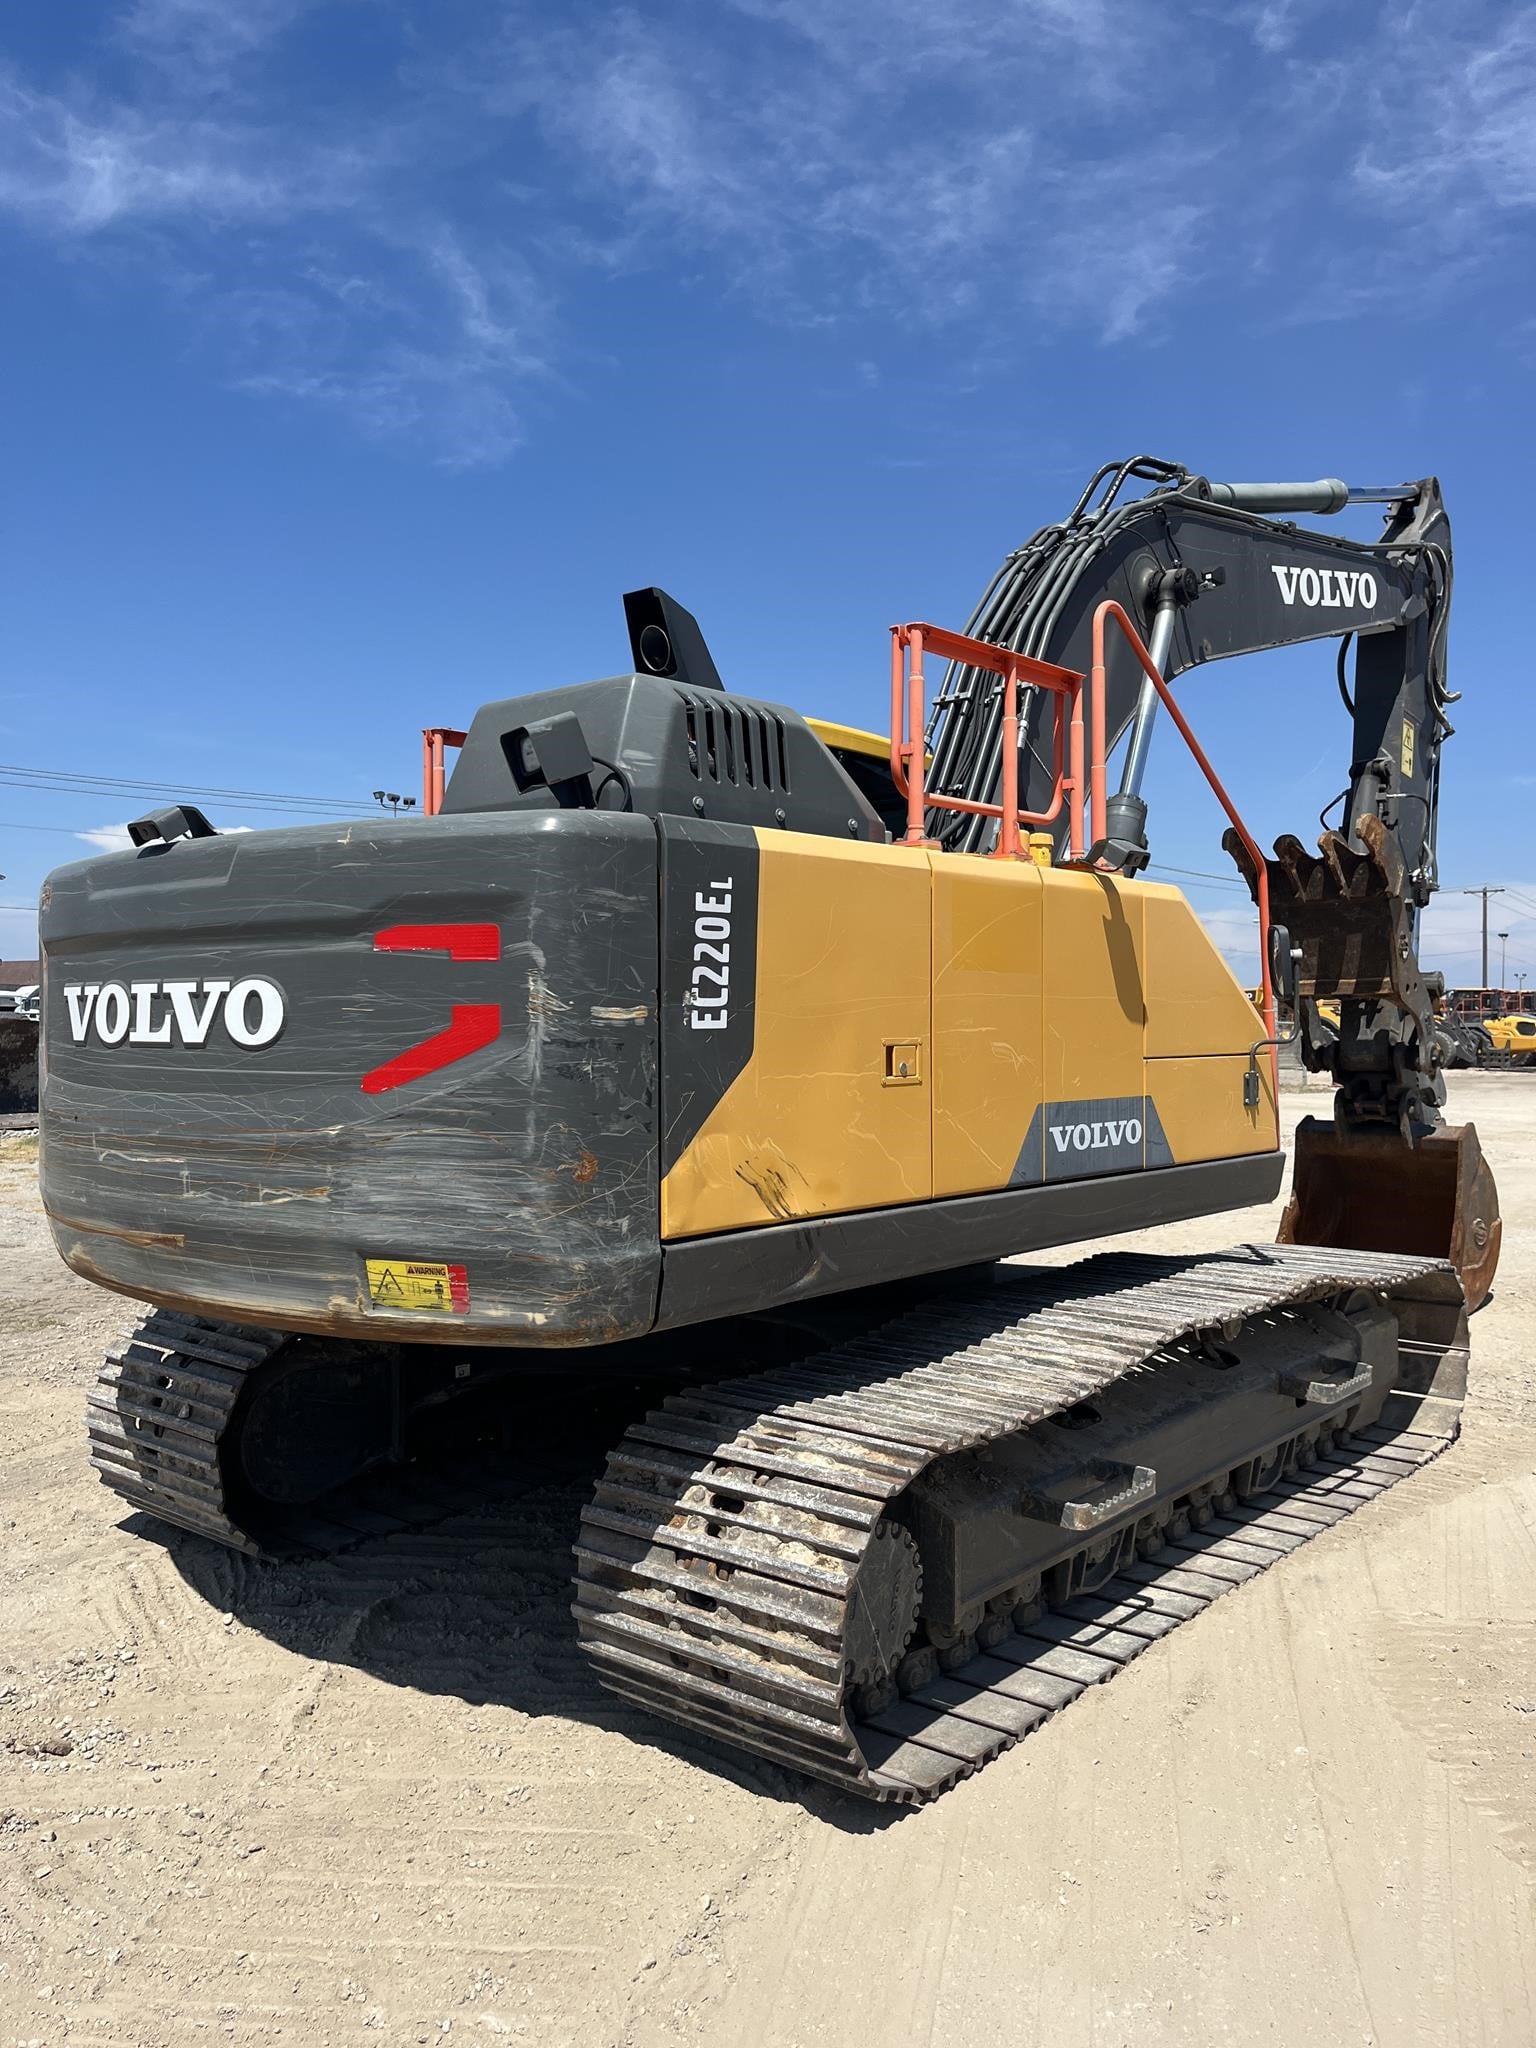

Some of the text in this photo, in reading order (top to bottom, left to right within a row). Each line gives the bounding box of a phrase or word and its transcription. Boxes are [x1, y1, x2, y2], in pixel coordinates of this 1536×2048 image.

[1271, 565, 1378, 609] VOLVO
[63, 977, 286, 1048] VOLVO
[1049, 1119, 1142, 1152] VOLVO
[414, 1265, 446, 1277] WARNING
